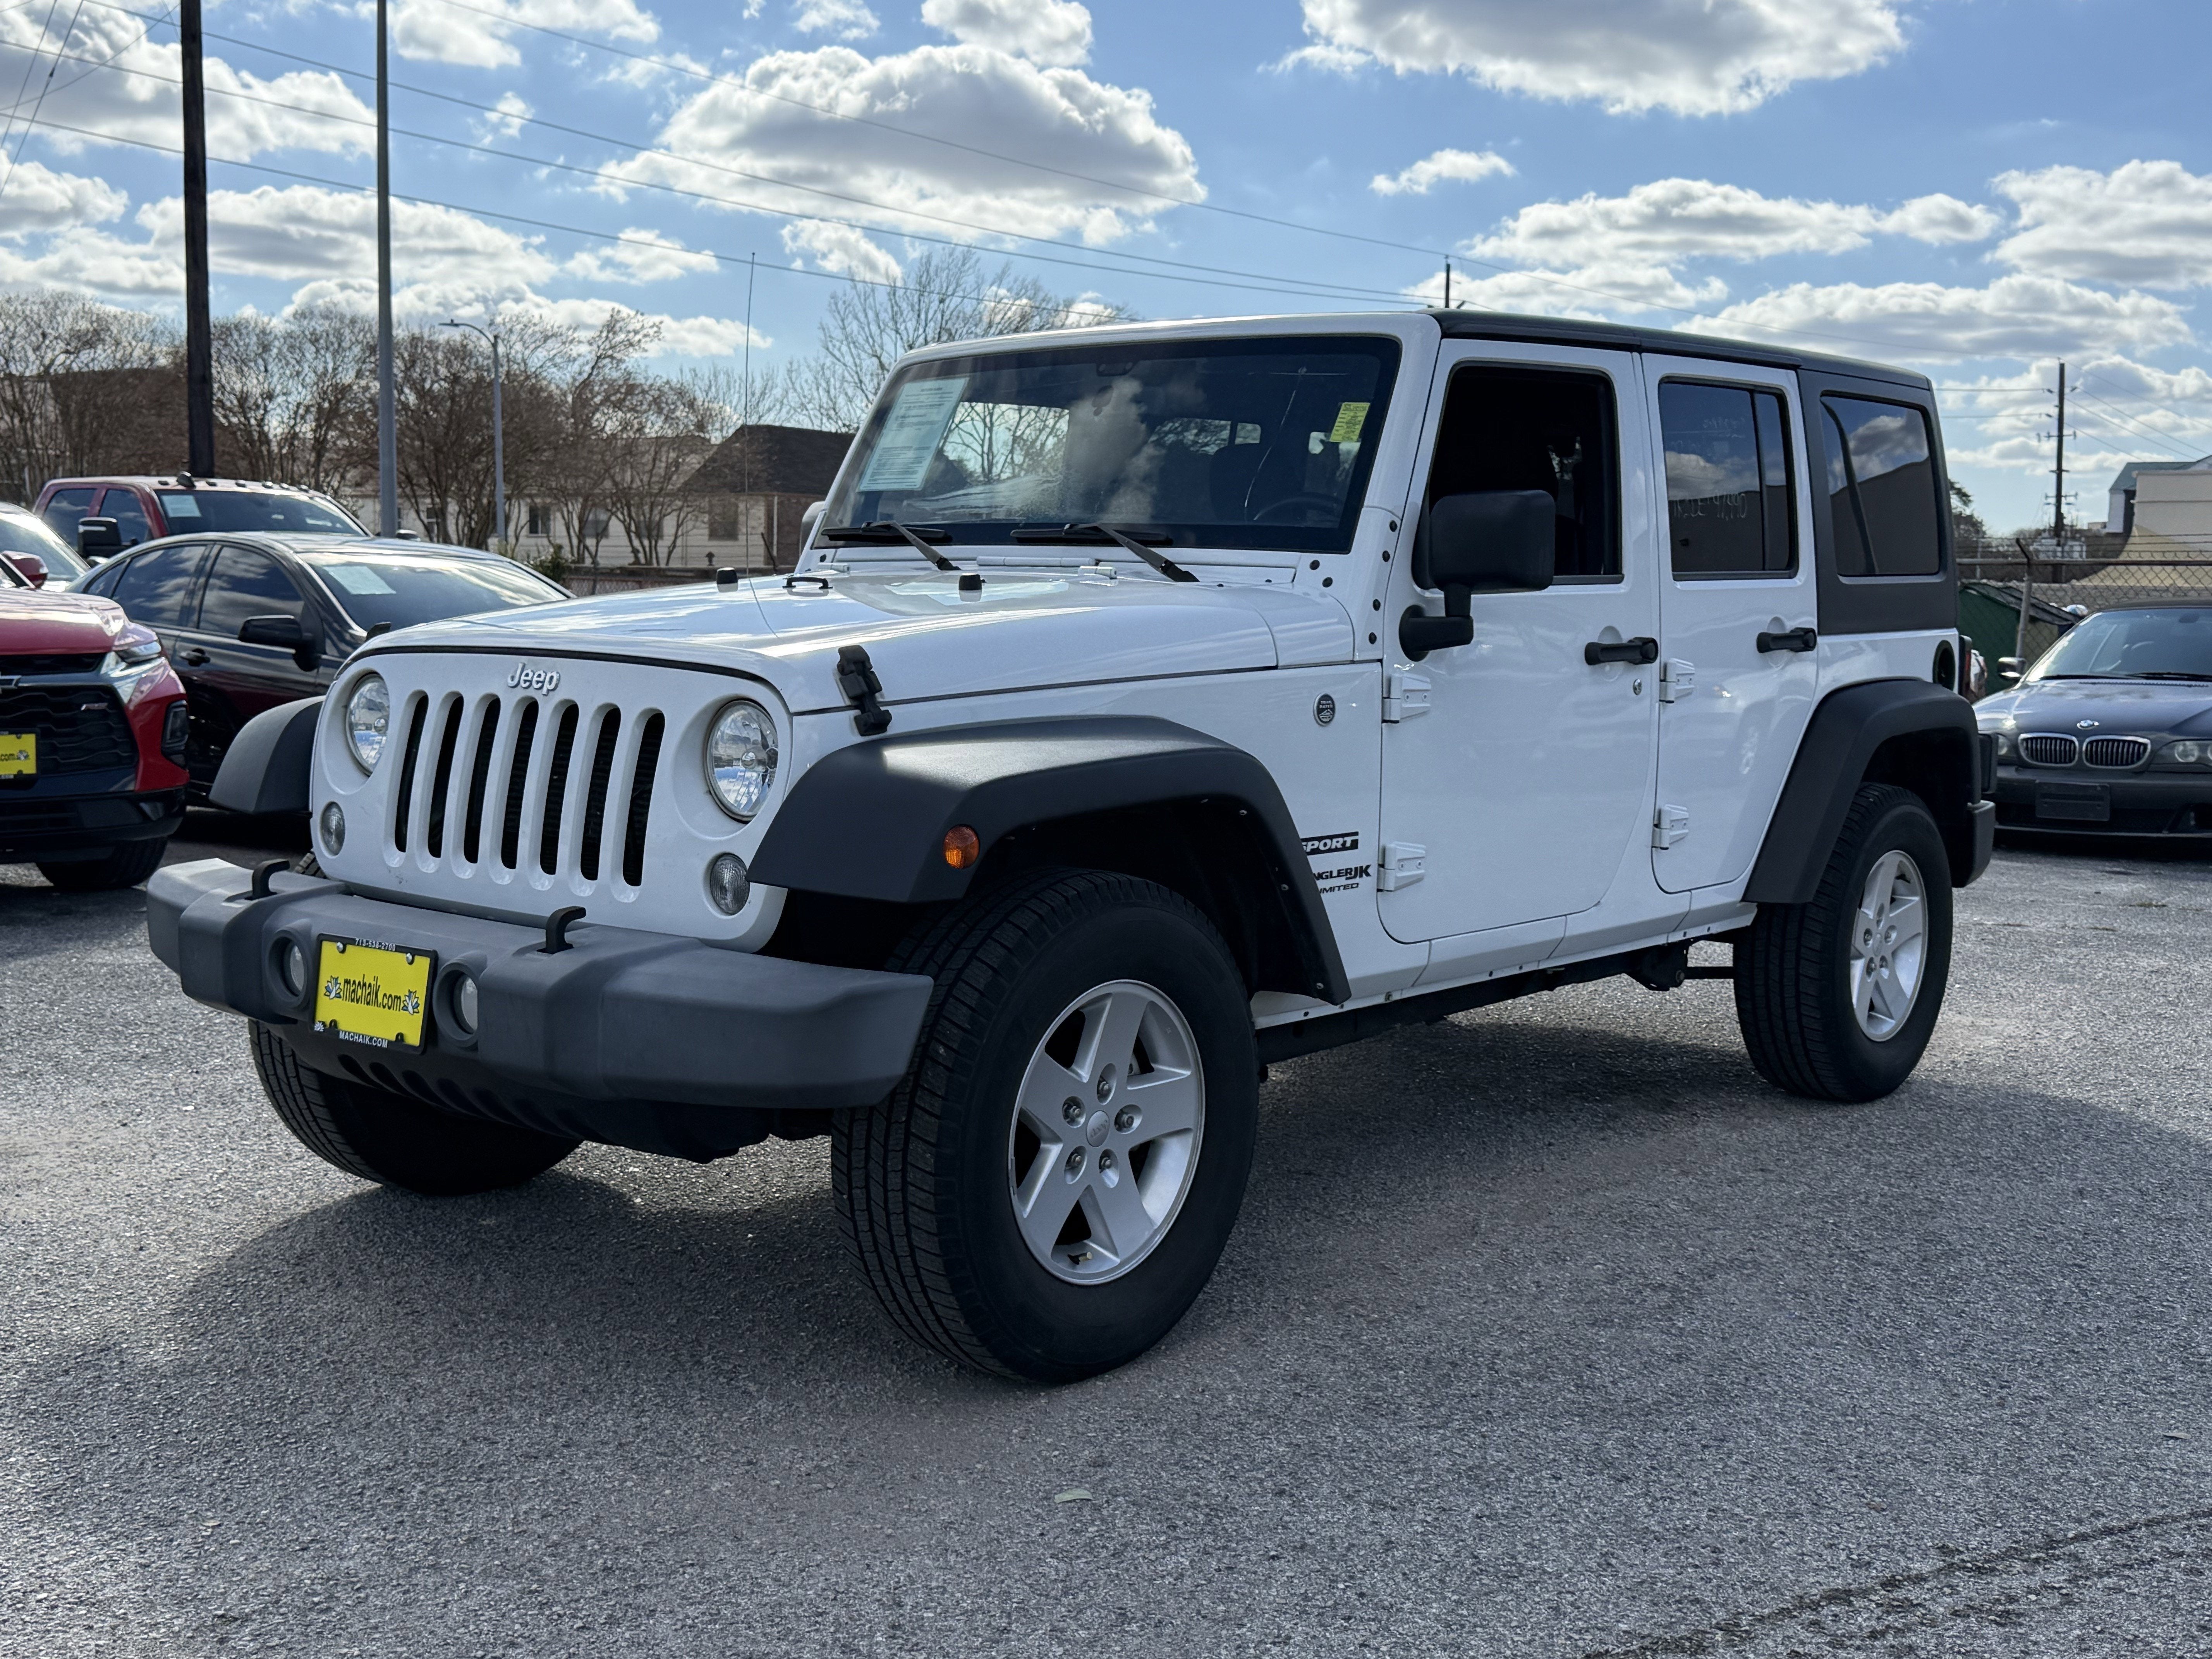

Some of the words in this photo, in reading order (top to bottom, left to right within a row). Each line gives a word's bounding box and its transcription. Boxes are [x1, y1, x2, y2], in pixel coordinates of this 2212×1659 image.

[508, 662, 560, 696] Jeep
[342, 974, 402, 1012] machaik.com
[339, 1030, 388, 1048] MACHAIK.COM
